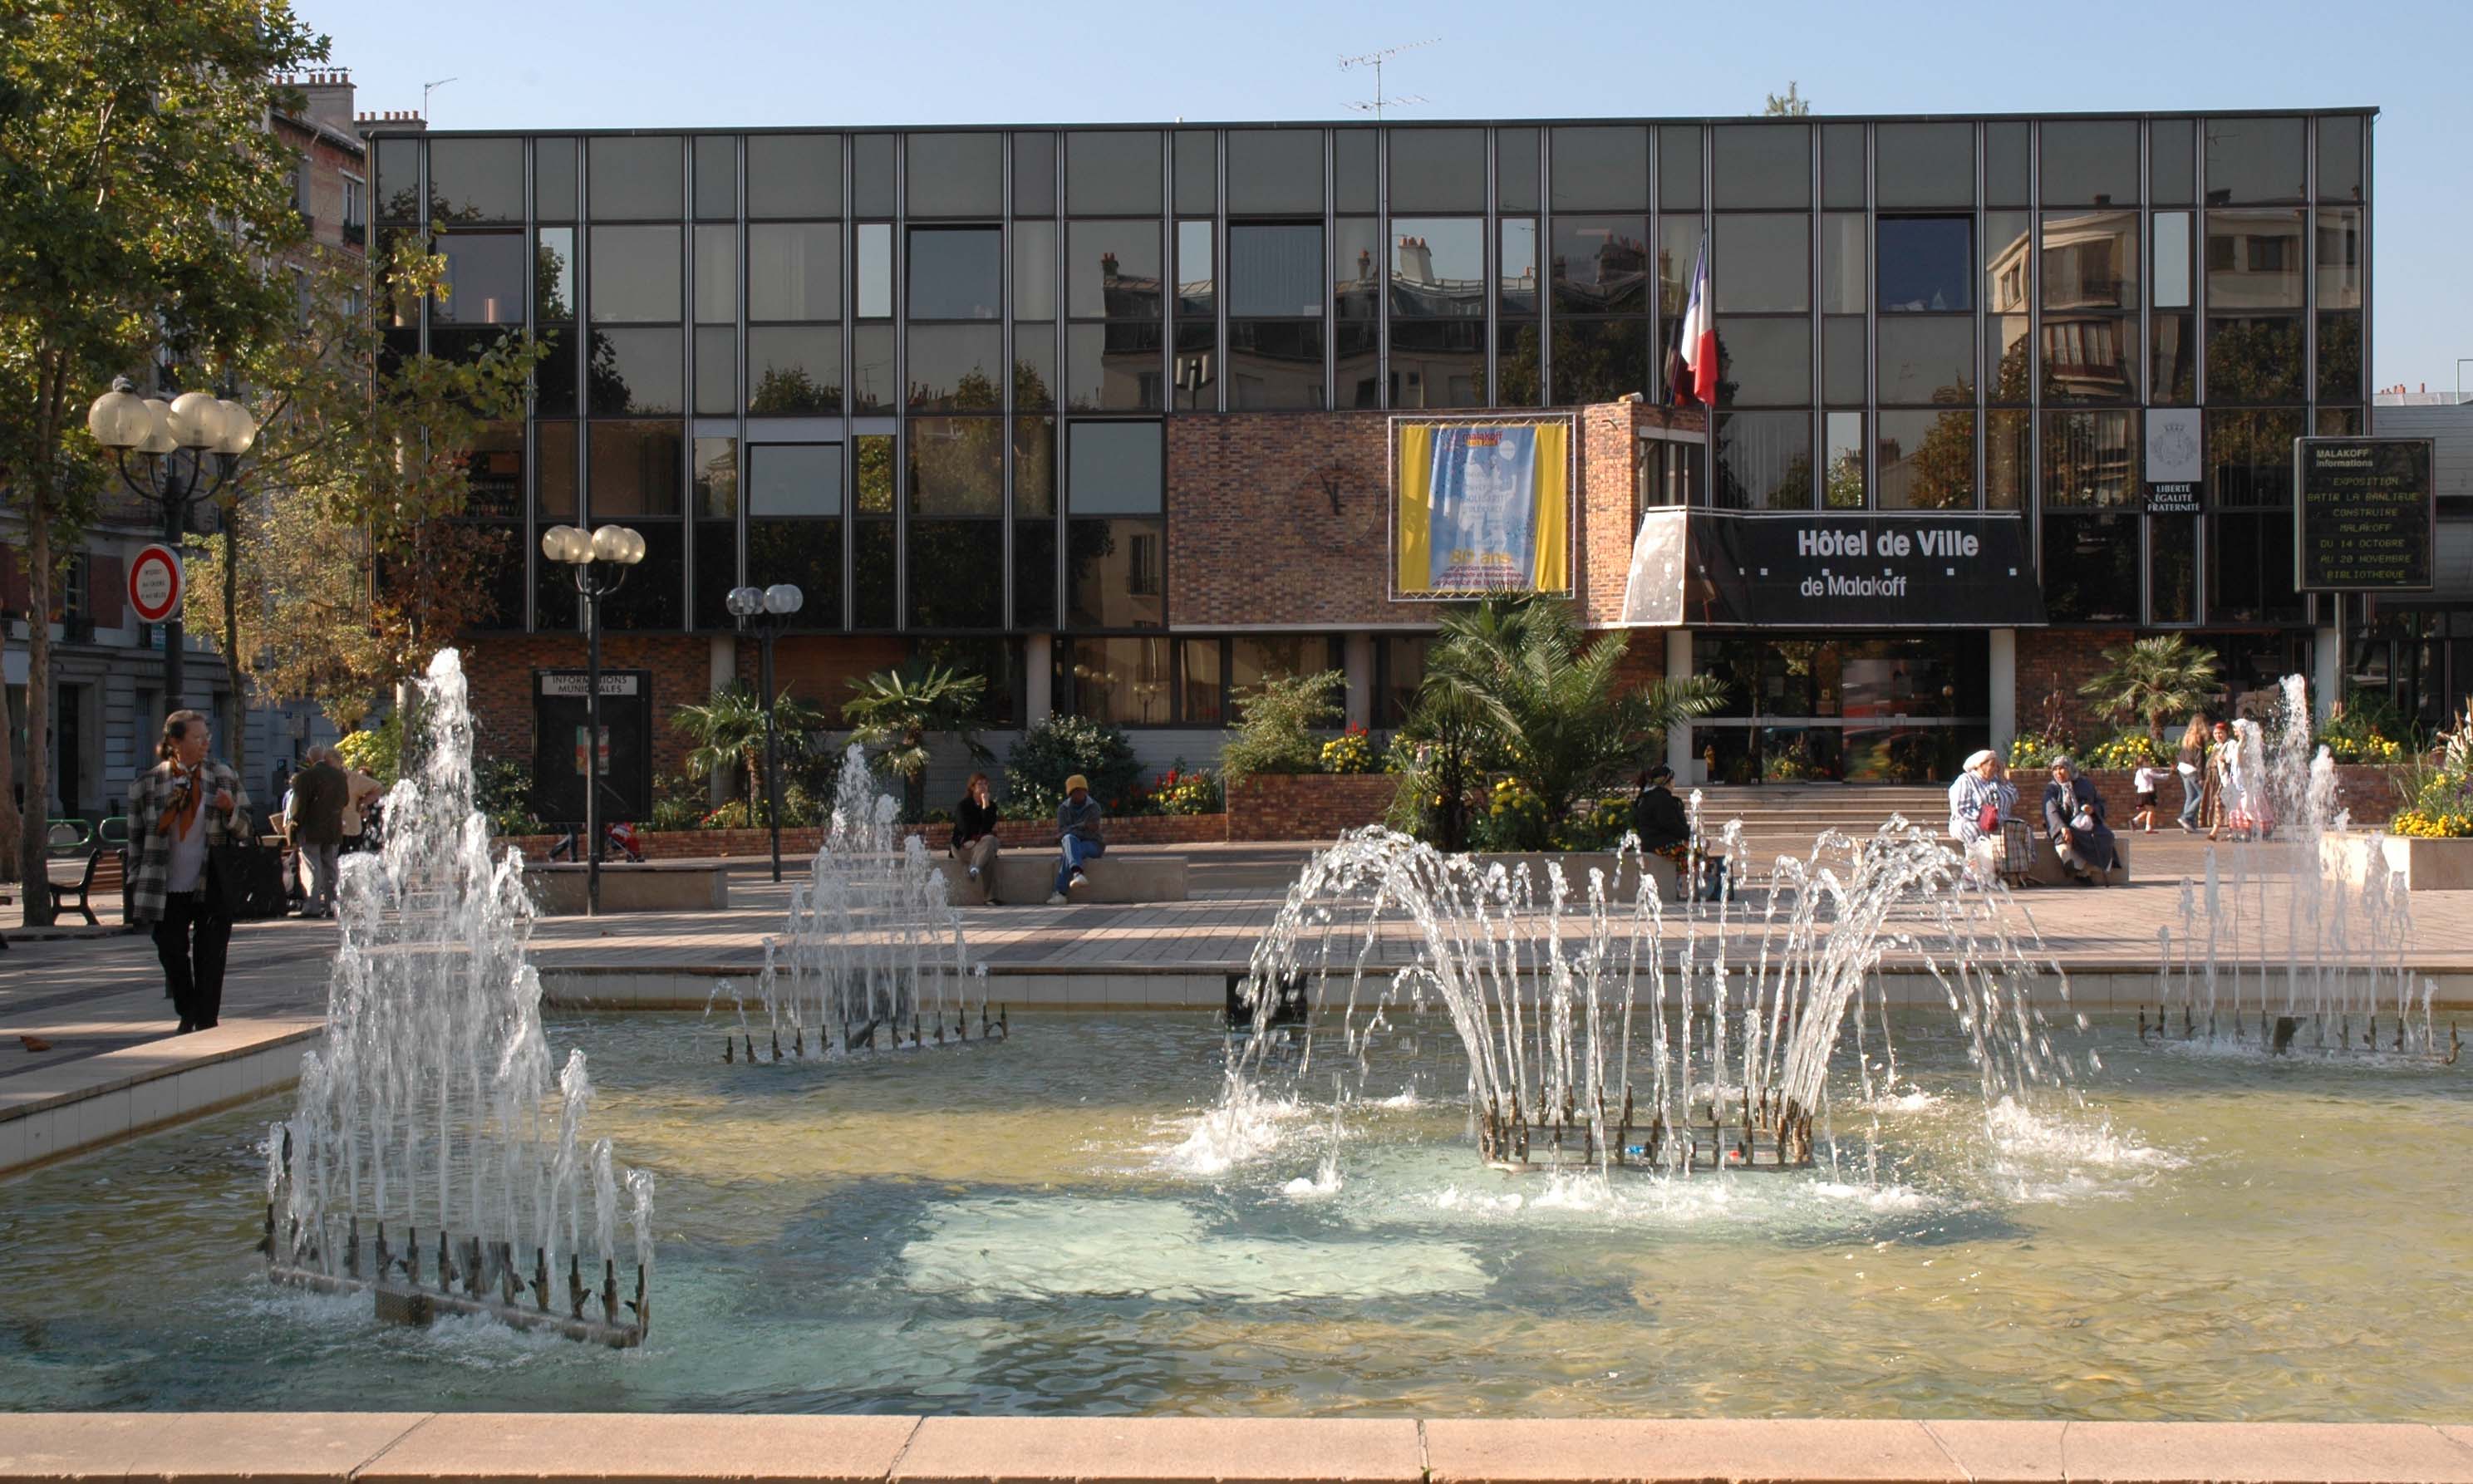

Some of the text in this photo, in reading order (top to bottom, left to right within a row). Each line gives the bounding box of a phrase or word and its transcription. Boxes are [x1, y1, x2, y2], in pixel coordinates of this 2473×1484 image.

[1463, 431, 1502, 440] malakoff
[2316, 450, 2368, 458] MALAKOFF
[2333, 477, 2399, 486] EXPOSITION
[2156, 484, 2190, 492] LIBERTÉ
[2307, 492, 2417, 502] BATIR LA BANLIEUE
[2147, 502, 2200, 512] FRATERNITÉ
[2333, 509, 2399, 517] CONSTRUIRE
[2339, 523, 2392, 533] MALAKOFF
[1798, 530, 1979, 557] Hôtel de Ville
[2320, 539, 2406, 548] DU 14 OCTOBRE
[1449, 548, 1512, 565] 80 ans
[2320, 554, 2333, 563] AU
[2359, 554, 2412, 563] NOVEMBRE
[2327, 570, 2407, 579] BIBLIOTHEQUE
[1801, 576, 1907, 597] de Malakoff
[553, 676, 627, 685] INFORMTIONS
[558, 685, 622, 693] MUNICALES
